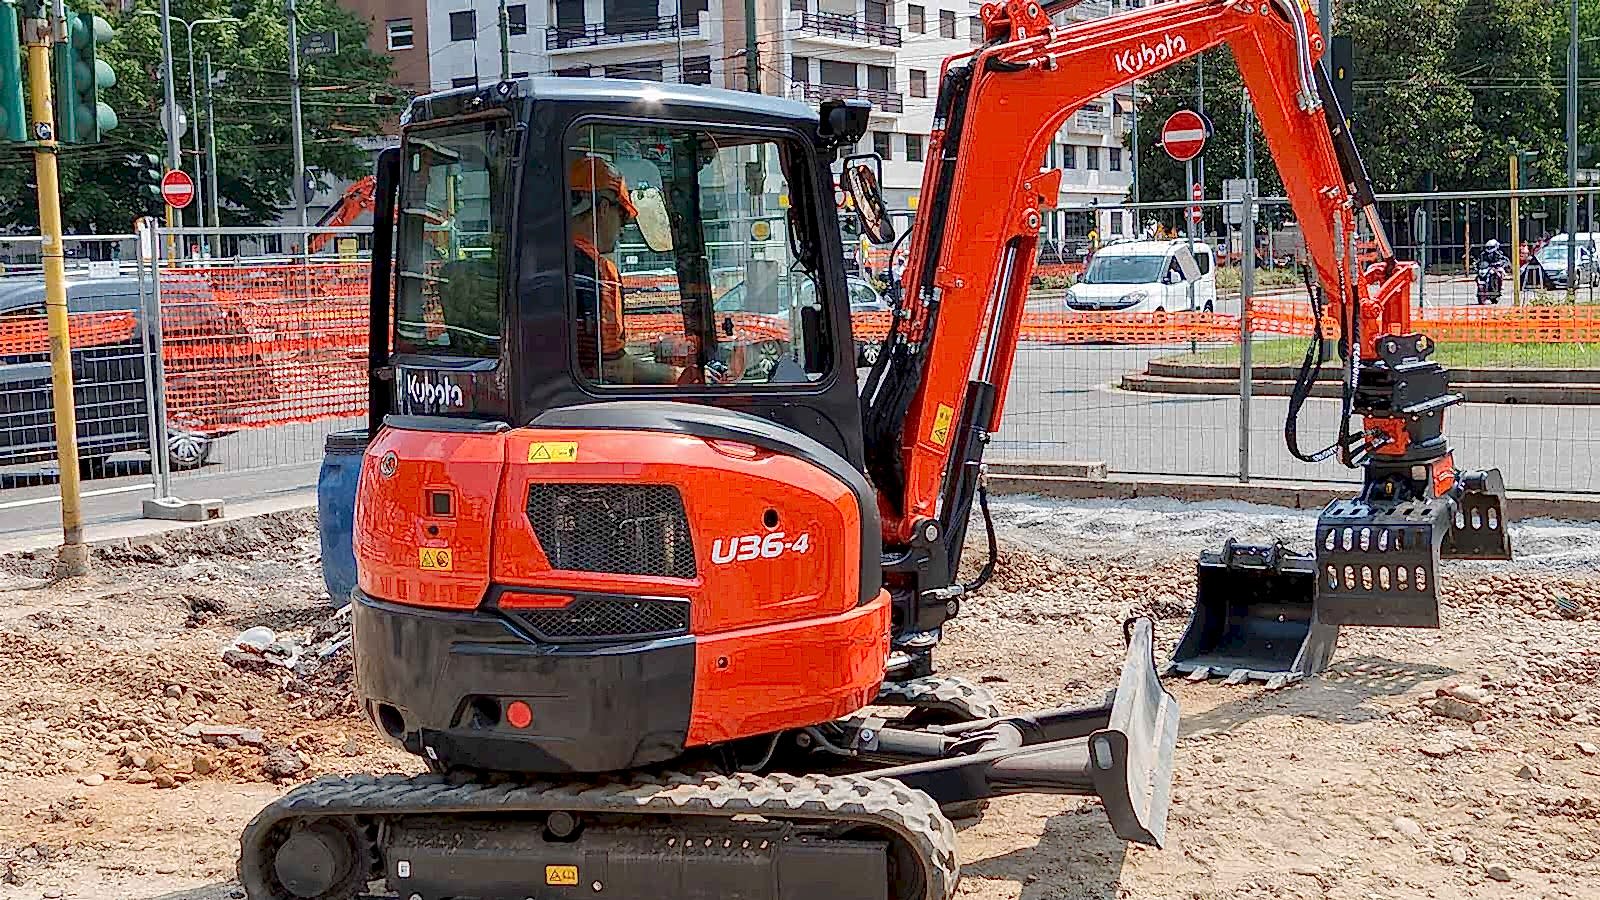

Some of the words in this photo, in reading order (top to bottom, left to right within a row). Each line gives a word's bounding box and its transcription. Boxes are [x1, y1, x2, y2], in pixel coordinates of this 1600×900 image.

[1114, 33, 1187, 74] Kubota
[407, 373, 463, 407] Kubota
[711, 531, 809, 564] U36-4
